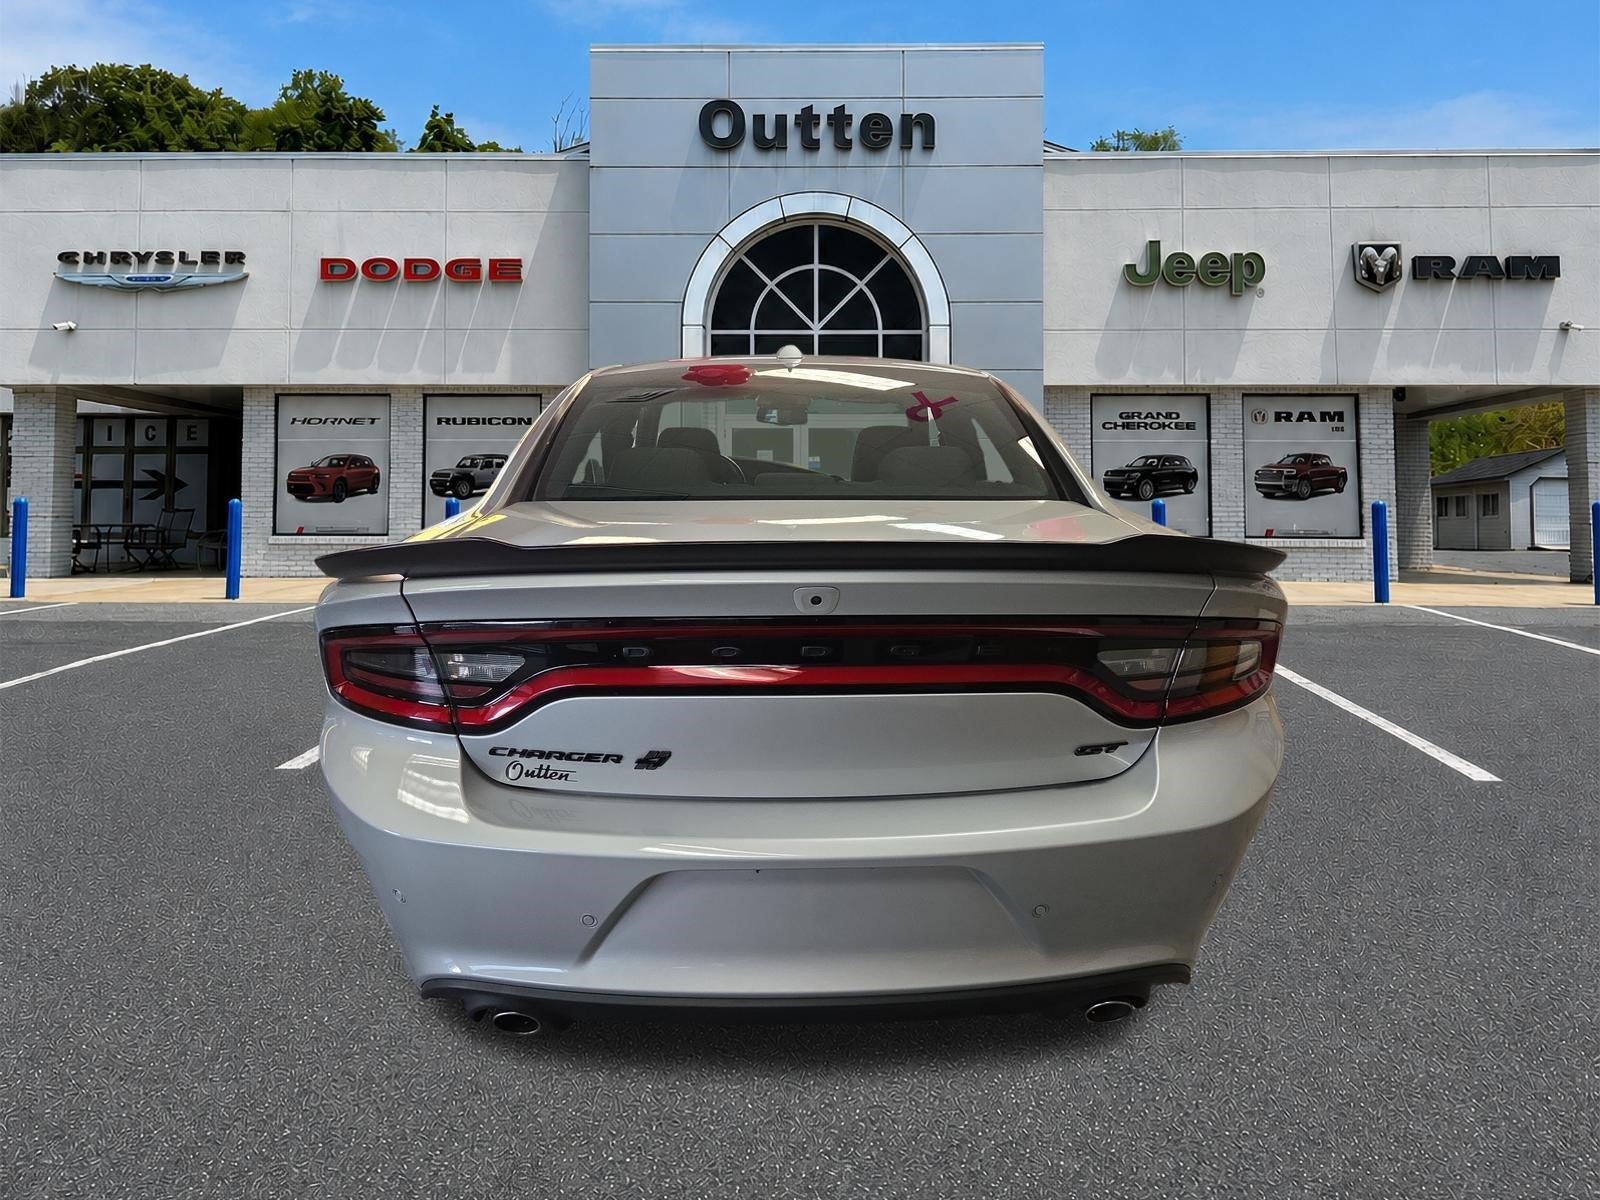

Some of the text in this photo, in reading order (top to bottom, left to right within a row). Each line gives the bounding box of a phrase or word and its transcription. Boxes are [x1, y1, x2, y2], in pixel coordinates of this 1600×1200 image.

[699, 99, 936, 150] Outten
[56, 250, 247, 266] CHRYSLER
[319, 257, 524, 282] DODGE
[1123, 240, 1266, 296] Jeep
[1411, 255, 1561, 280] RAM
[289, 416, 382, 427] HORNET
[436, 416, 533, 426] RUBICON
[1118, 411, 1181, 420] GRAND
[1273, 410, 1345, 423] RAM
[1101, 421, 1197, 431] CHEROKEE
[488, 746, 624, 764] CHARGER
[1074, 741, 1129, 757] GT
[505, 760, 578, 783] Outten
